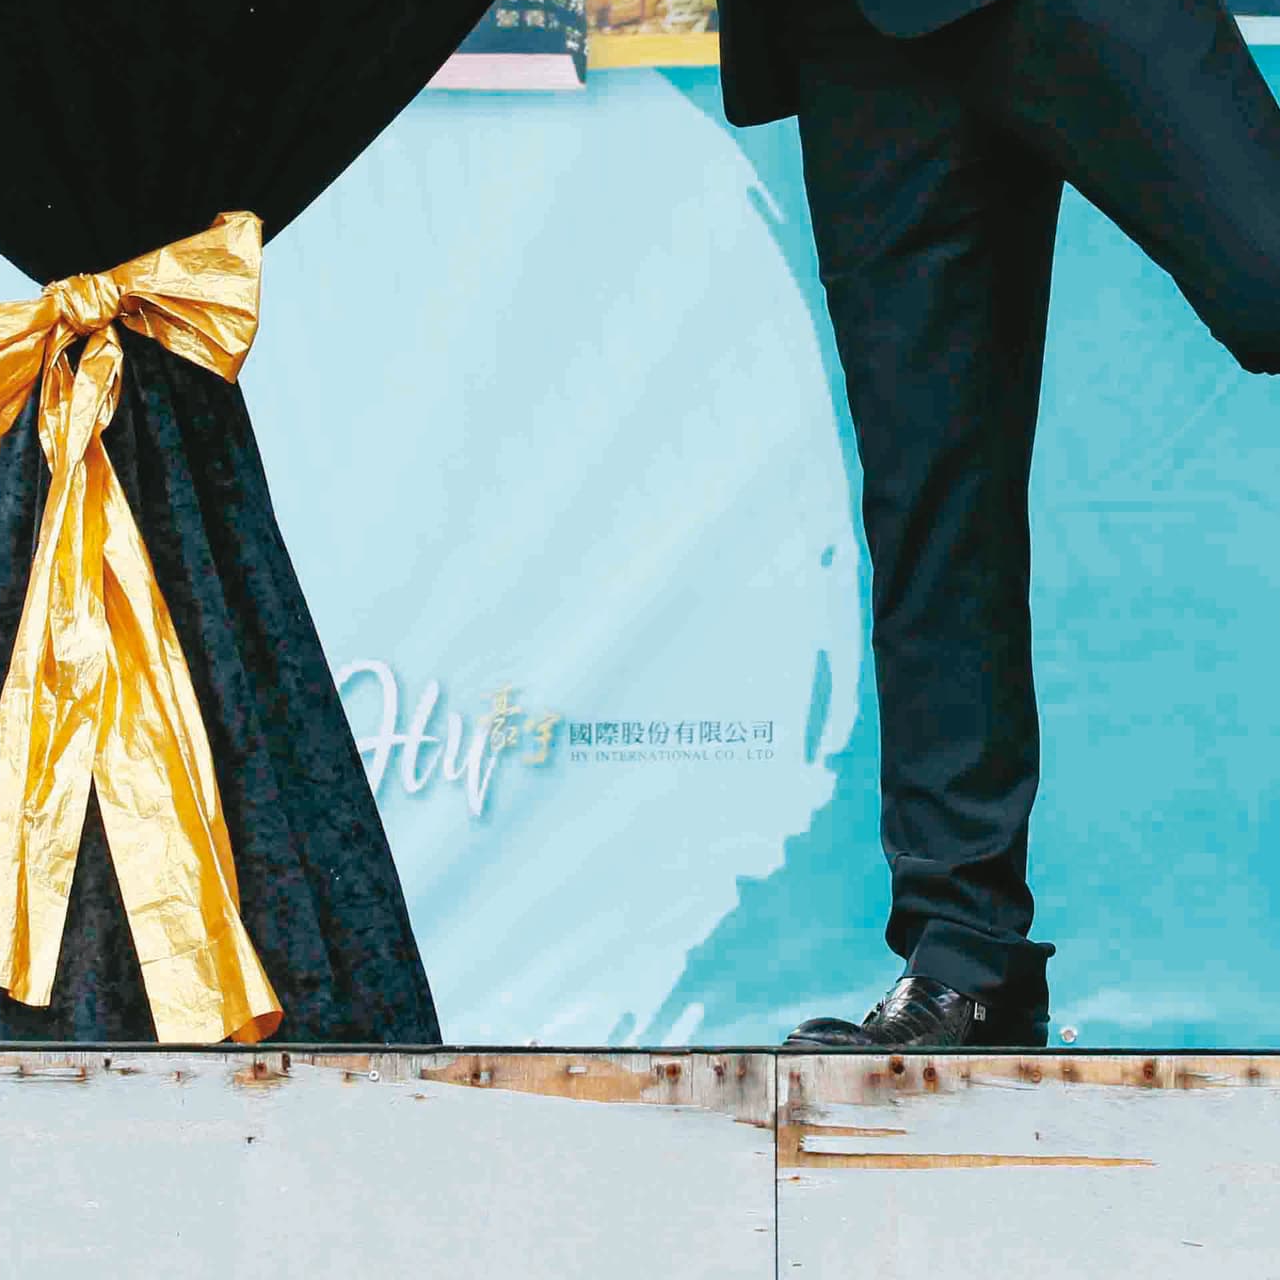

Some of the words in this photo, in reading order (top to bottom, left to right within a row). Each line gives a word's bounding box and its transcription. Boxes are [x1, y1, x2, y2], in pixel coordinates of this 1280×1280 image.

[569, 720, 774, 745] 國際股份有限公司
[571, 751, 588, 761] HY
[596, 750, 708, 761] INTERNATIONAL
